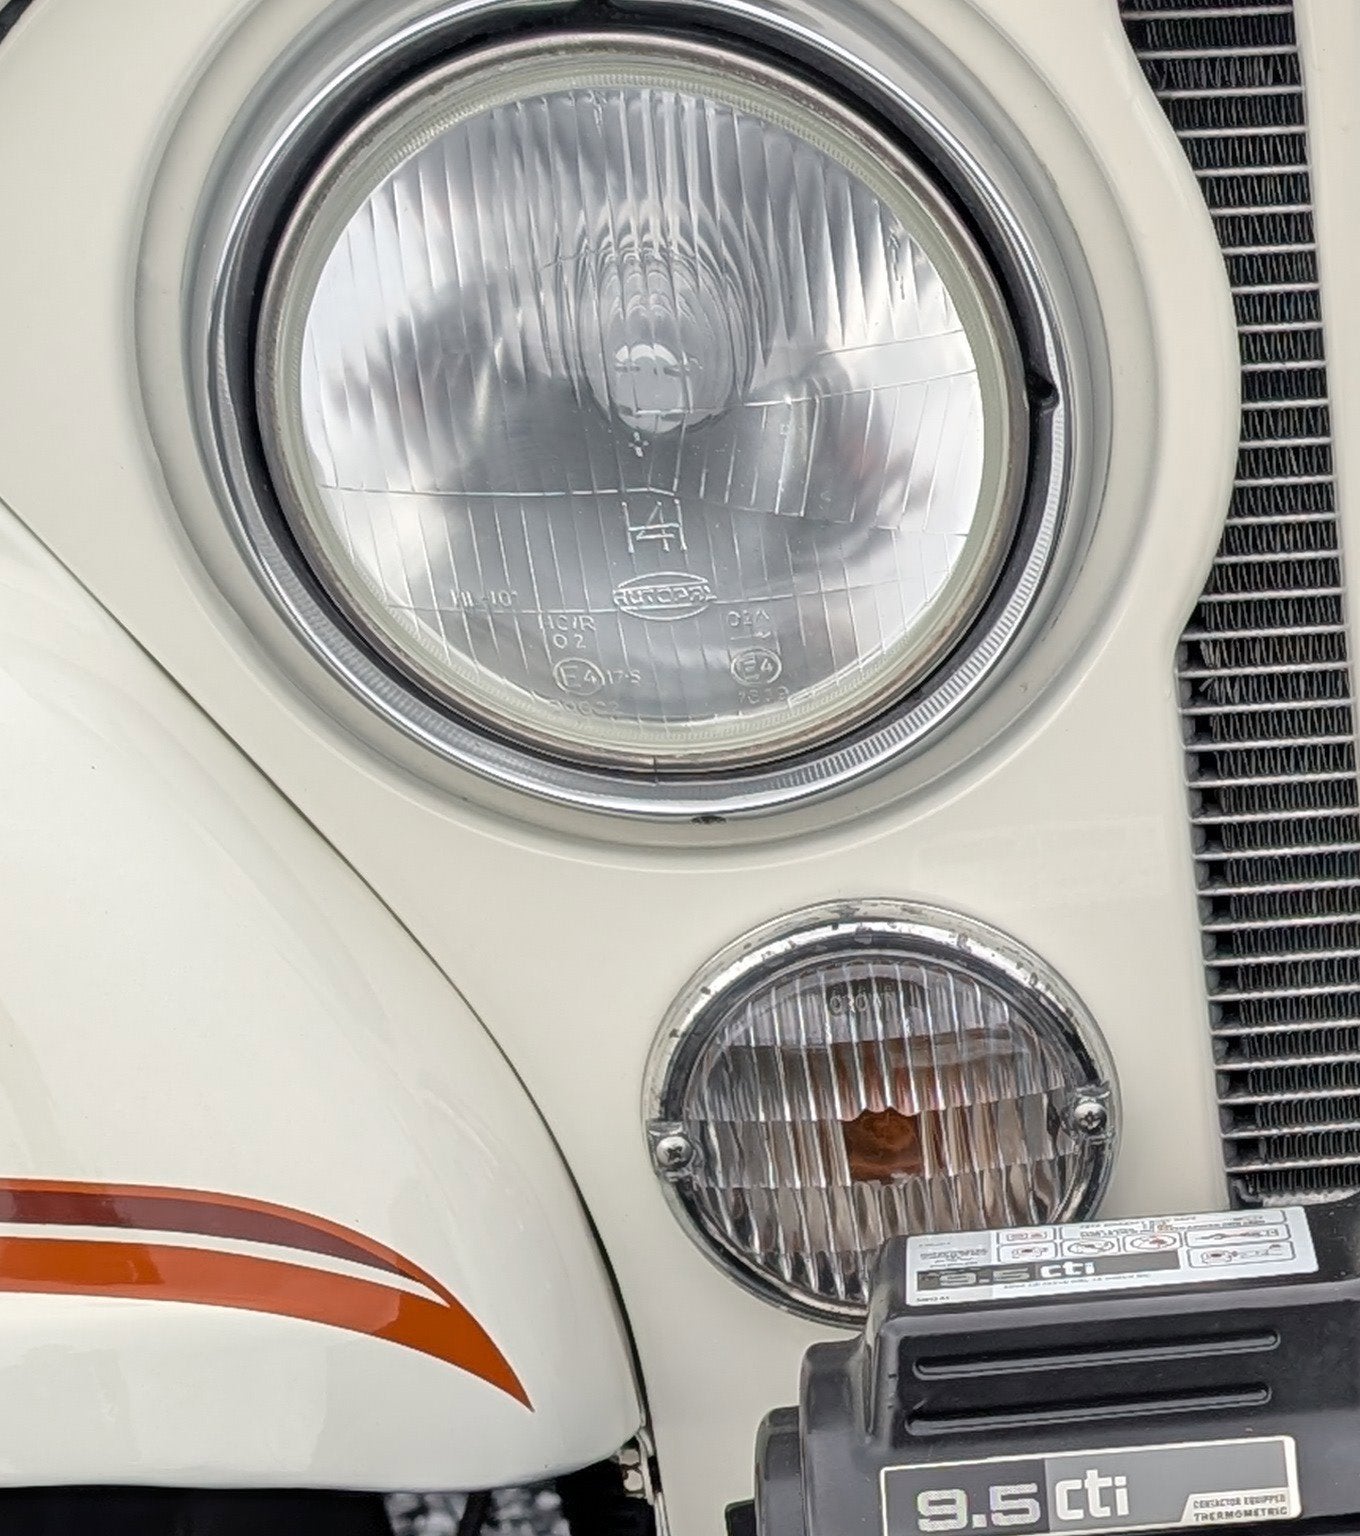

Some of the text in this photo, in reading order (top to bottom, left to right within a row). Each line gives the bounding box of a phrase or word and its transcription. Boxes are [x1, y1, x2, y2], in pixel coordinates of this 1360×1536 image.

[916, 1469, 1130, 1532] 9.5 cti
[1193, 1506, 1288, 1522] THERMOMETRIC
